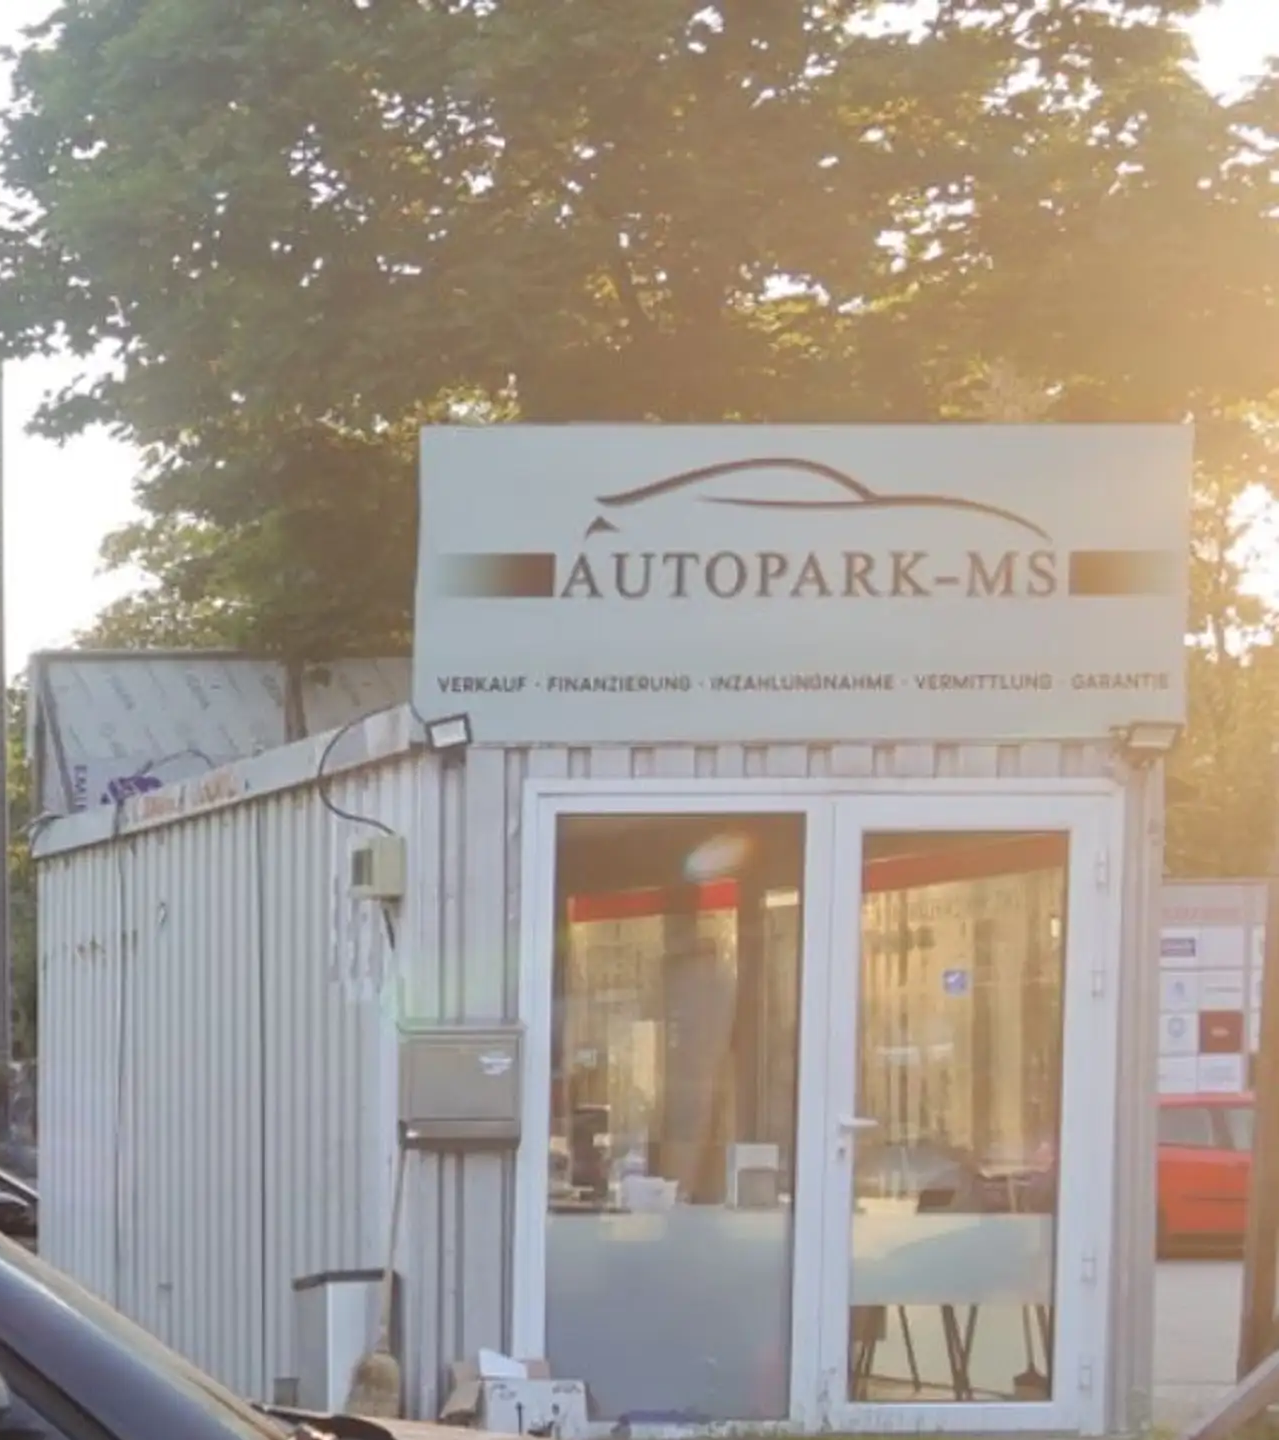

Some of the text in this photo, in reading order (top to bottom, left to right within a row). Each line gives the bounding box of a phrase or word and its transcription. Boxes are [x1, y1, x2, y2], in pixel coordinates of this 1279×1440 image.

[560, 550, 1058, 599] AUTOPARK-MS
[437, 675, 528, 693] VERKAUF
[546, 674, 692, 692] FINANZIERUNG
[914, 673, 1053, 690] VERMITTLUNG
[1070, 672, 1170, 690] GARANTIE
